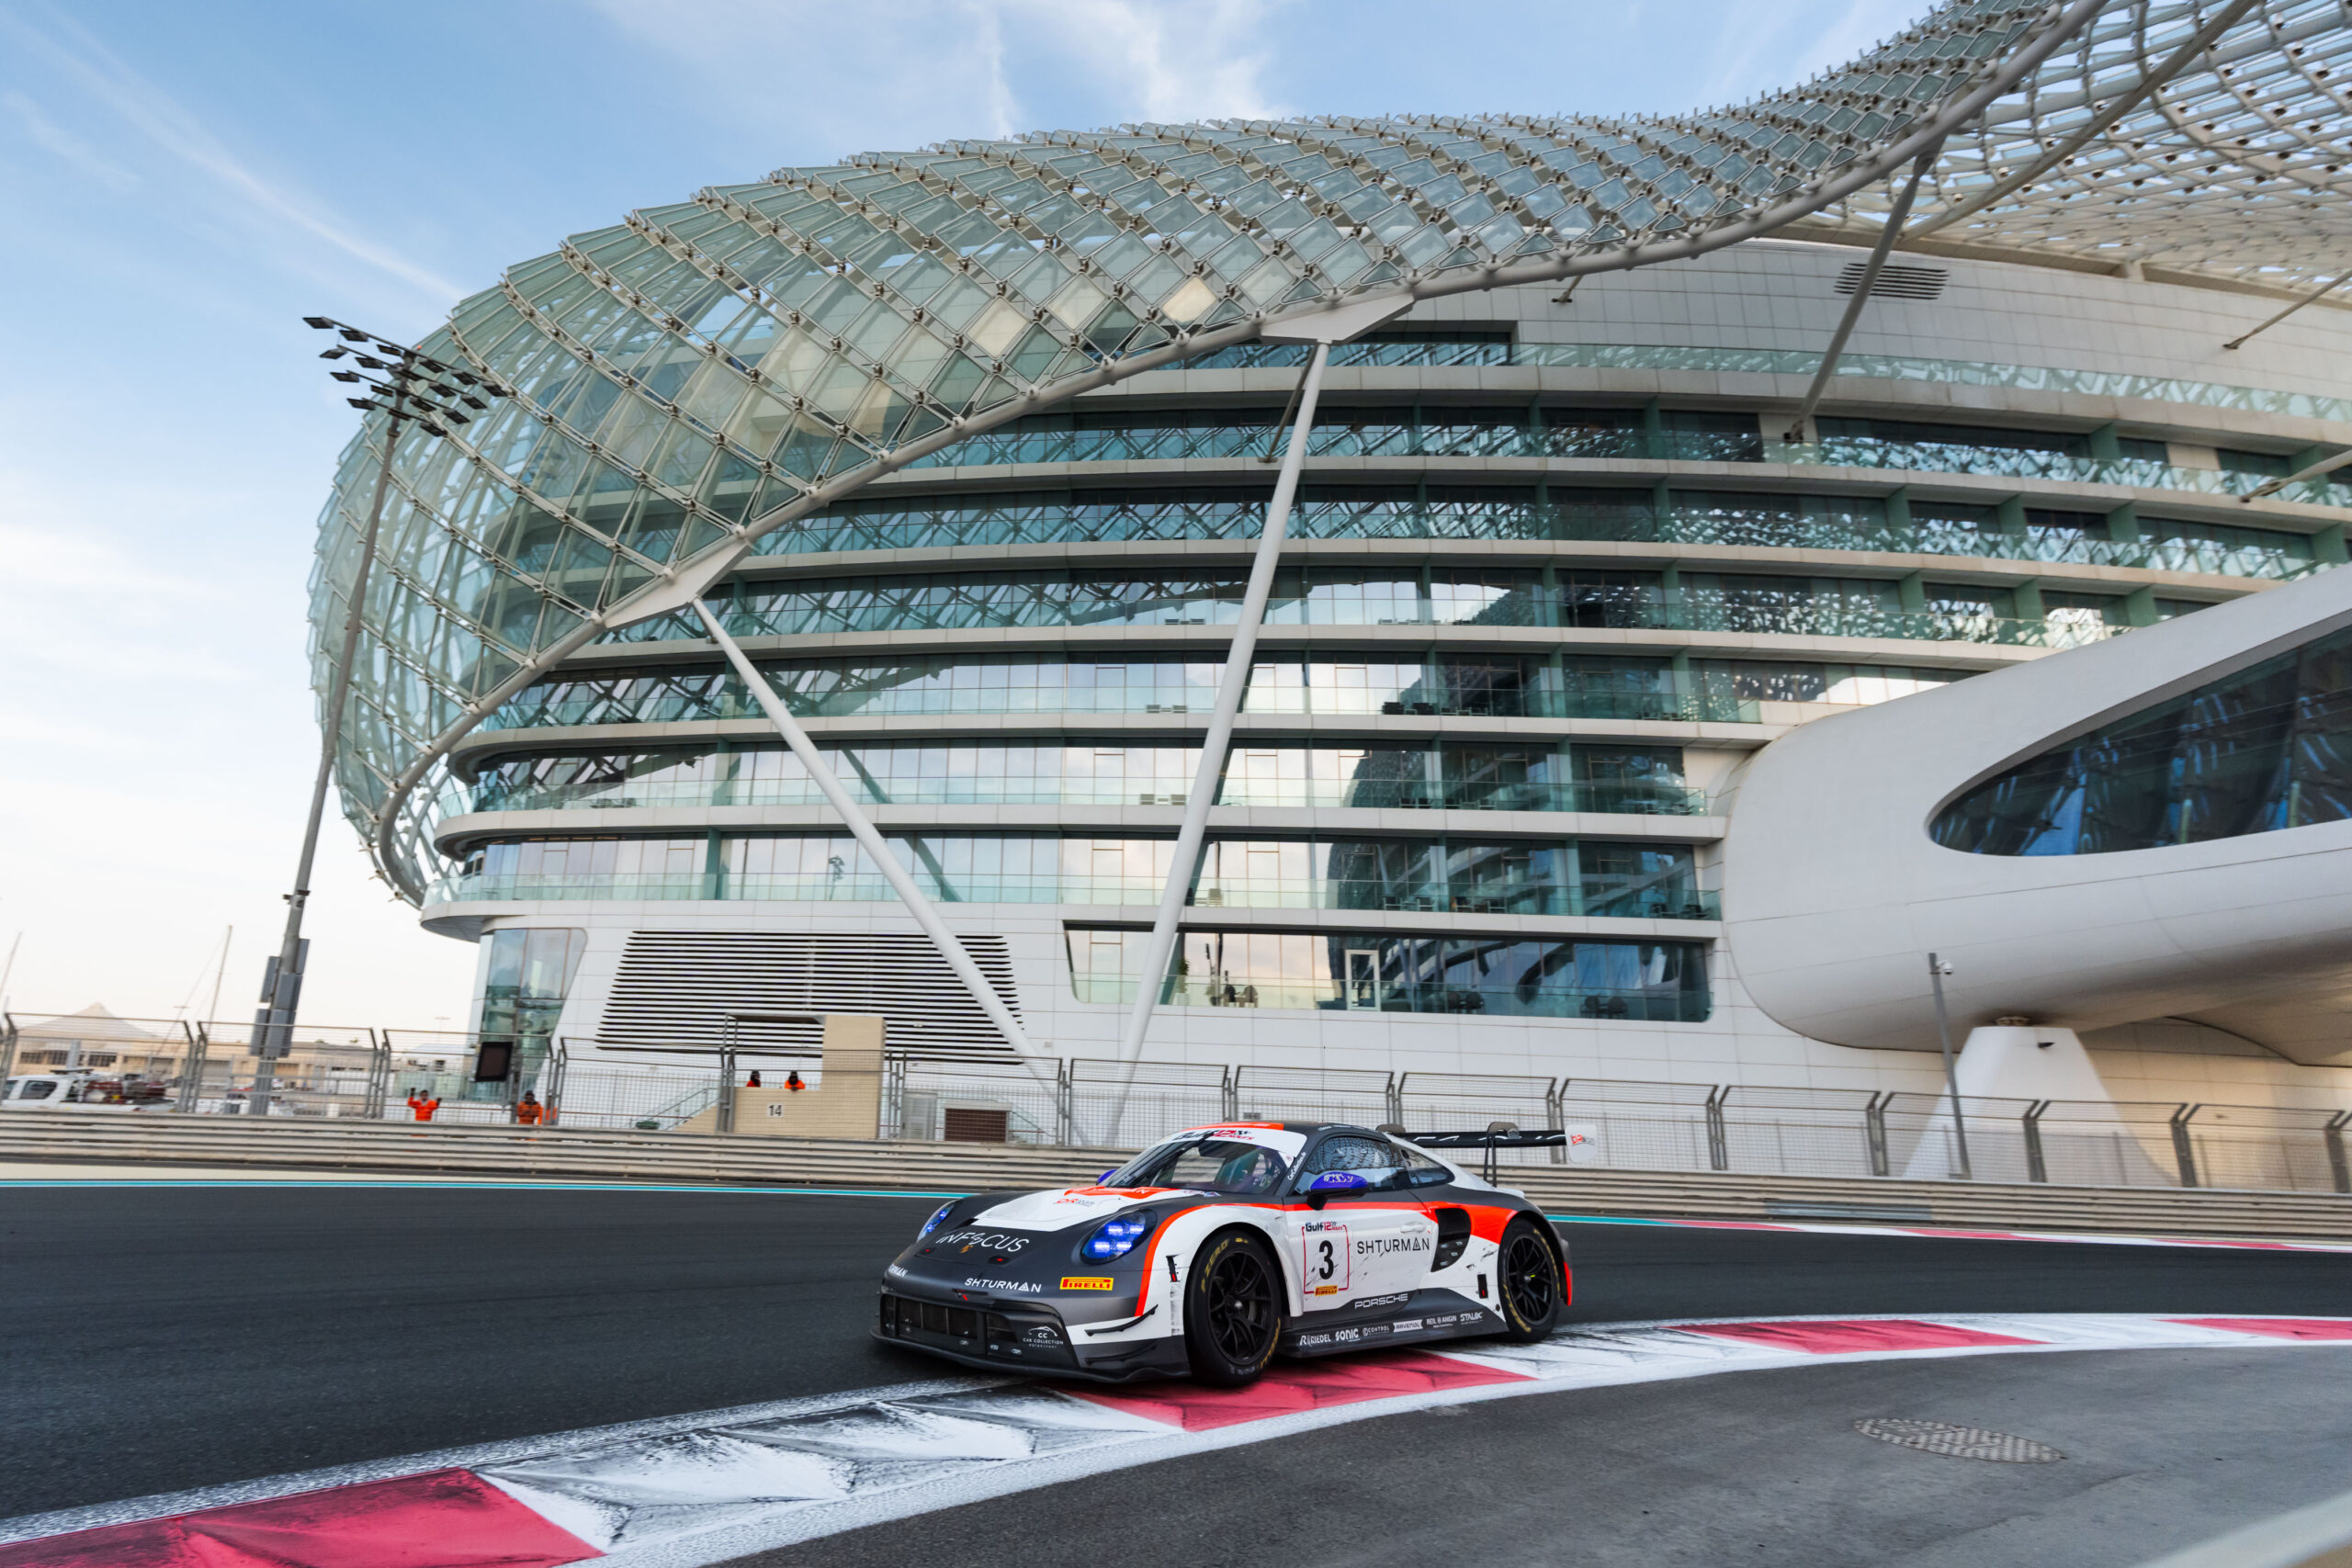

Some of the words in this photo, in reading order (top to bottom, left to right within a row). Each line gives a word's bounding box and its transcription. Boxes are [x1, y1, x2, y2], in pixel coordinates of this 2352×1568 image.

[768, 1104, 782, 1117] 14
[1357, 1237, 1430, 1255] SHTURMAN
[1318, 1240, 1334, 1280] 3
[965, 1278, 1042, 1293] SHTURMAN
[1062, 1279, 1112, 1289] PIRELLI
[1354, 1293, 1408, 1309] PORSCHE
[1335, 1328, 1359, 1341] SONIC
